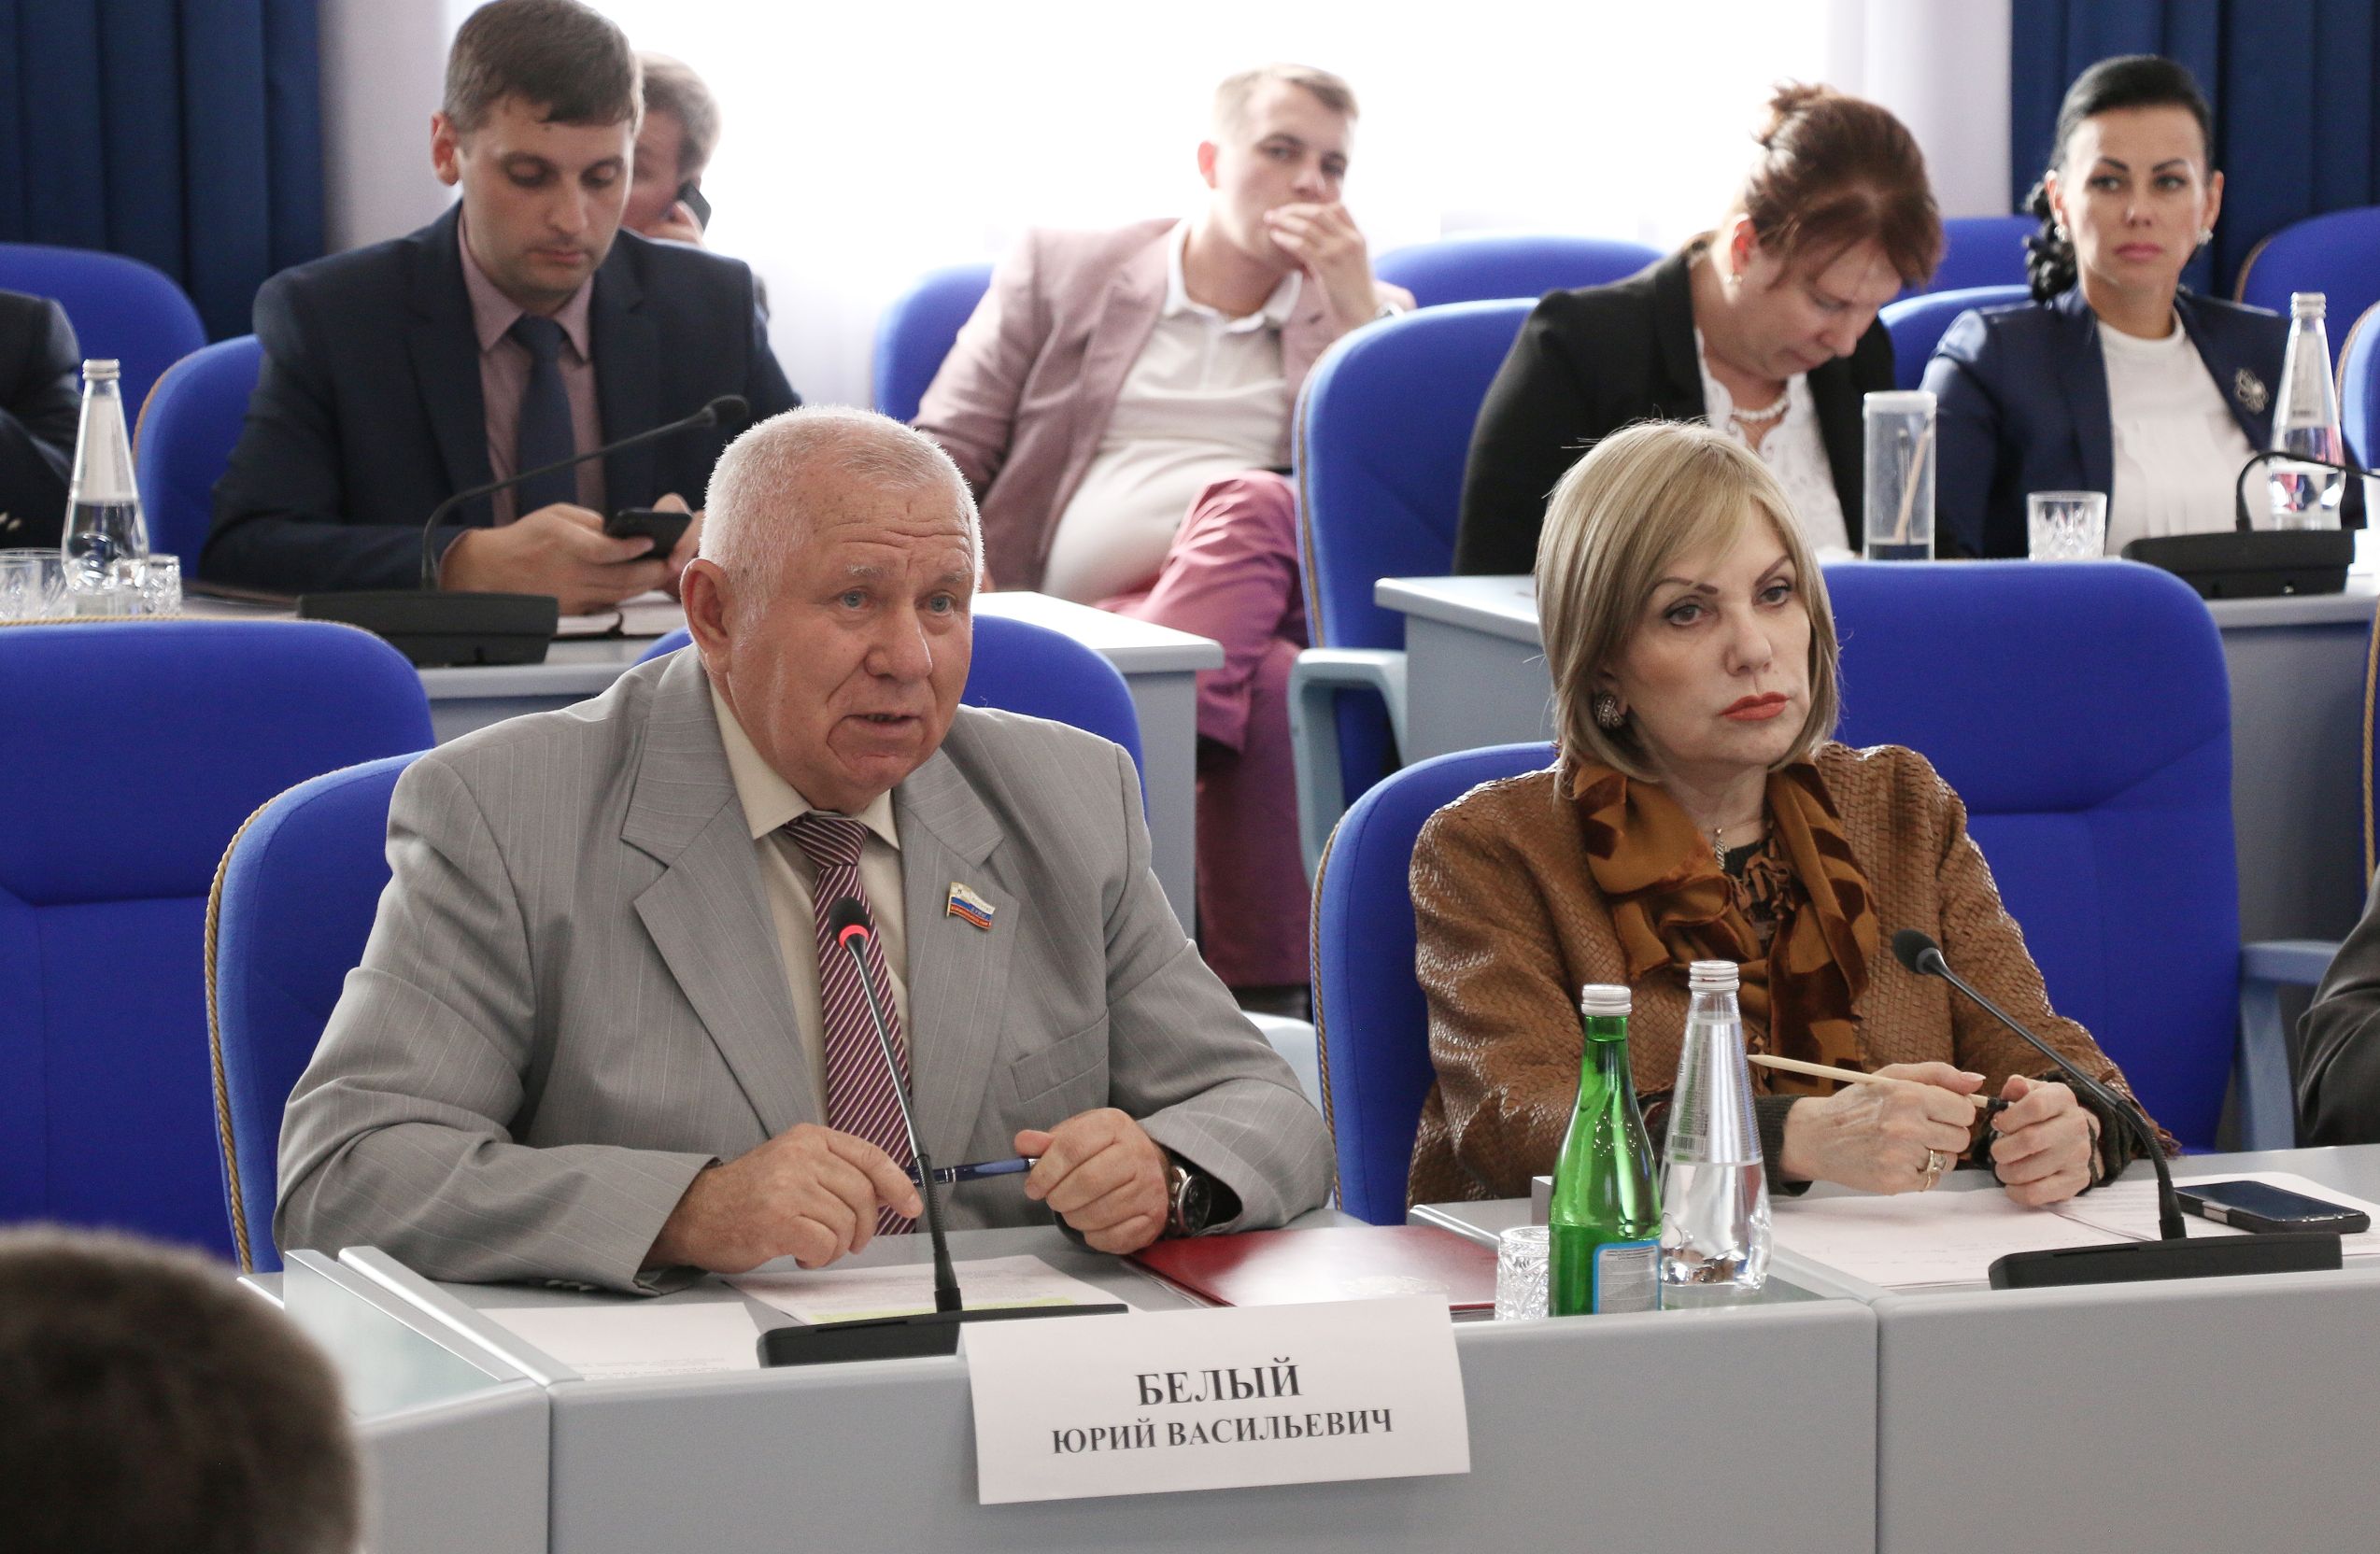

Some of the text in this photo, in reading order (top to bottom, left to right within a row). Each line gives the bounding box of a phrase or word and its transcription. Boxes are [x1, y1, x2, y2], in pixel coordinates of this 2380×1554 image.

[1136, 1357, 1302, 1406] БЕЛЫЙ
[1052, 1409, 1393, 1454] ЮРИЙ ВАСИЛЬЕВИЧ
